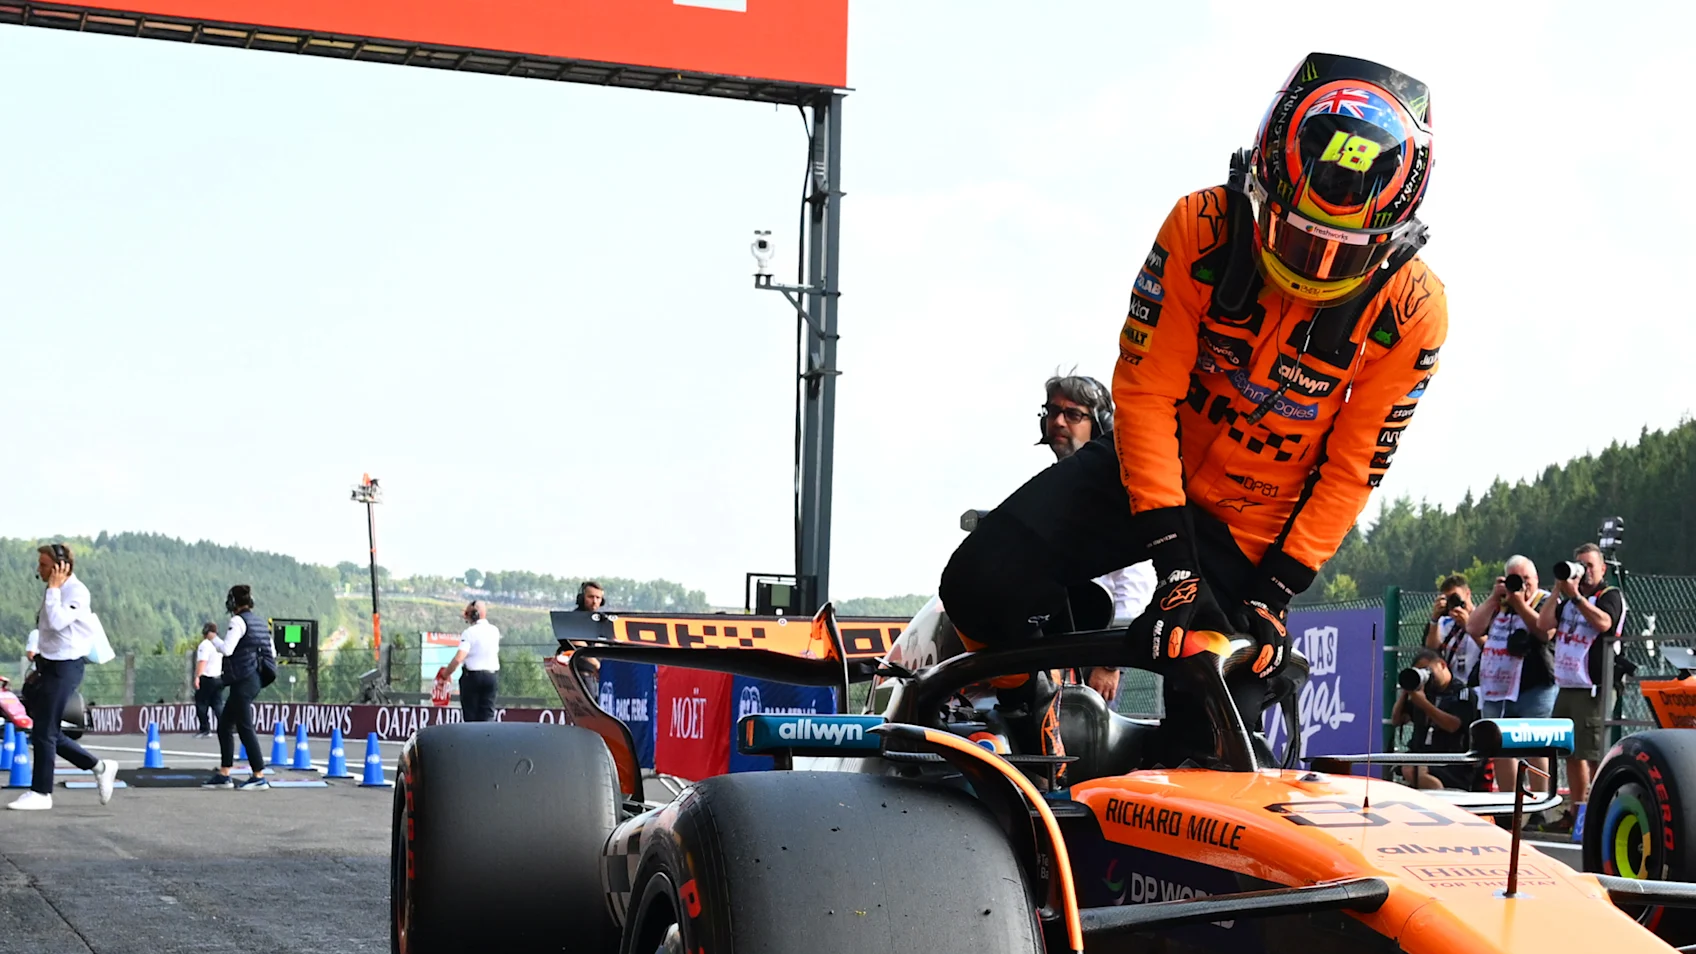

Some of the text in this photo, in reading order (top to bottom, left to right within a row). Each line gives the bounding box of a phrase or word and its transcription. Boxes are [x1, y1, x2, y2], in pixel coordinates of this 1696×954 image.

[1313, 226, 1349, 242] freshworks
[1129, 297, 1151, 321] kta
[1278, 364, 1331, 394] allwyn
[1307, 631, 1334, 670] LAS
[138, 706, 176, 733] QATAR
[292, 705, 352, 735] AIRWAYS
[376, 706, 430, 739] QATAR
[616, 697, 631, 721] PARC
[669, 688, 707, 739] MOËT
[778, 719, 864, 746] allwyn
[1510, 722, 1566, 746] allwyn
[1105, 797, 1247, 851] RICHARD MILLE
[1376, 843, 1509, 856] allwyn
[1420, 866, 1540, 879] Hilton
[1131, 872, 1158, 902] DP
